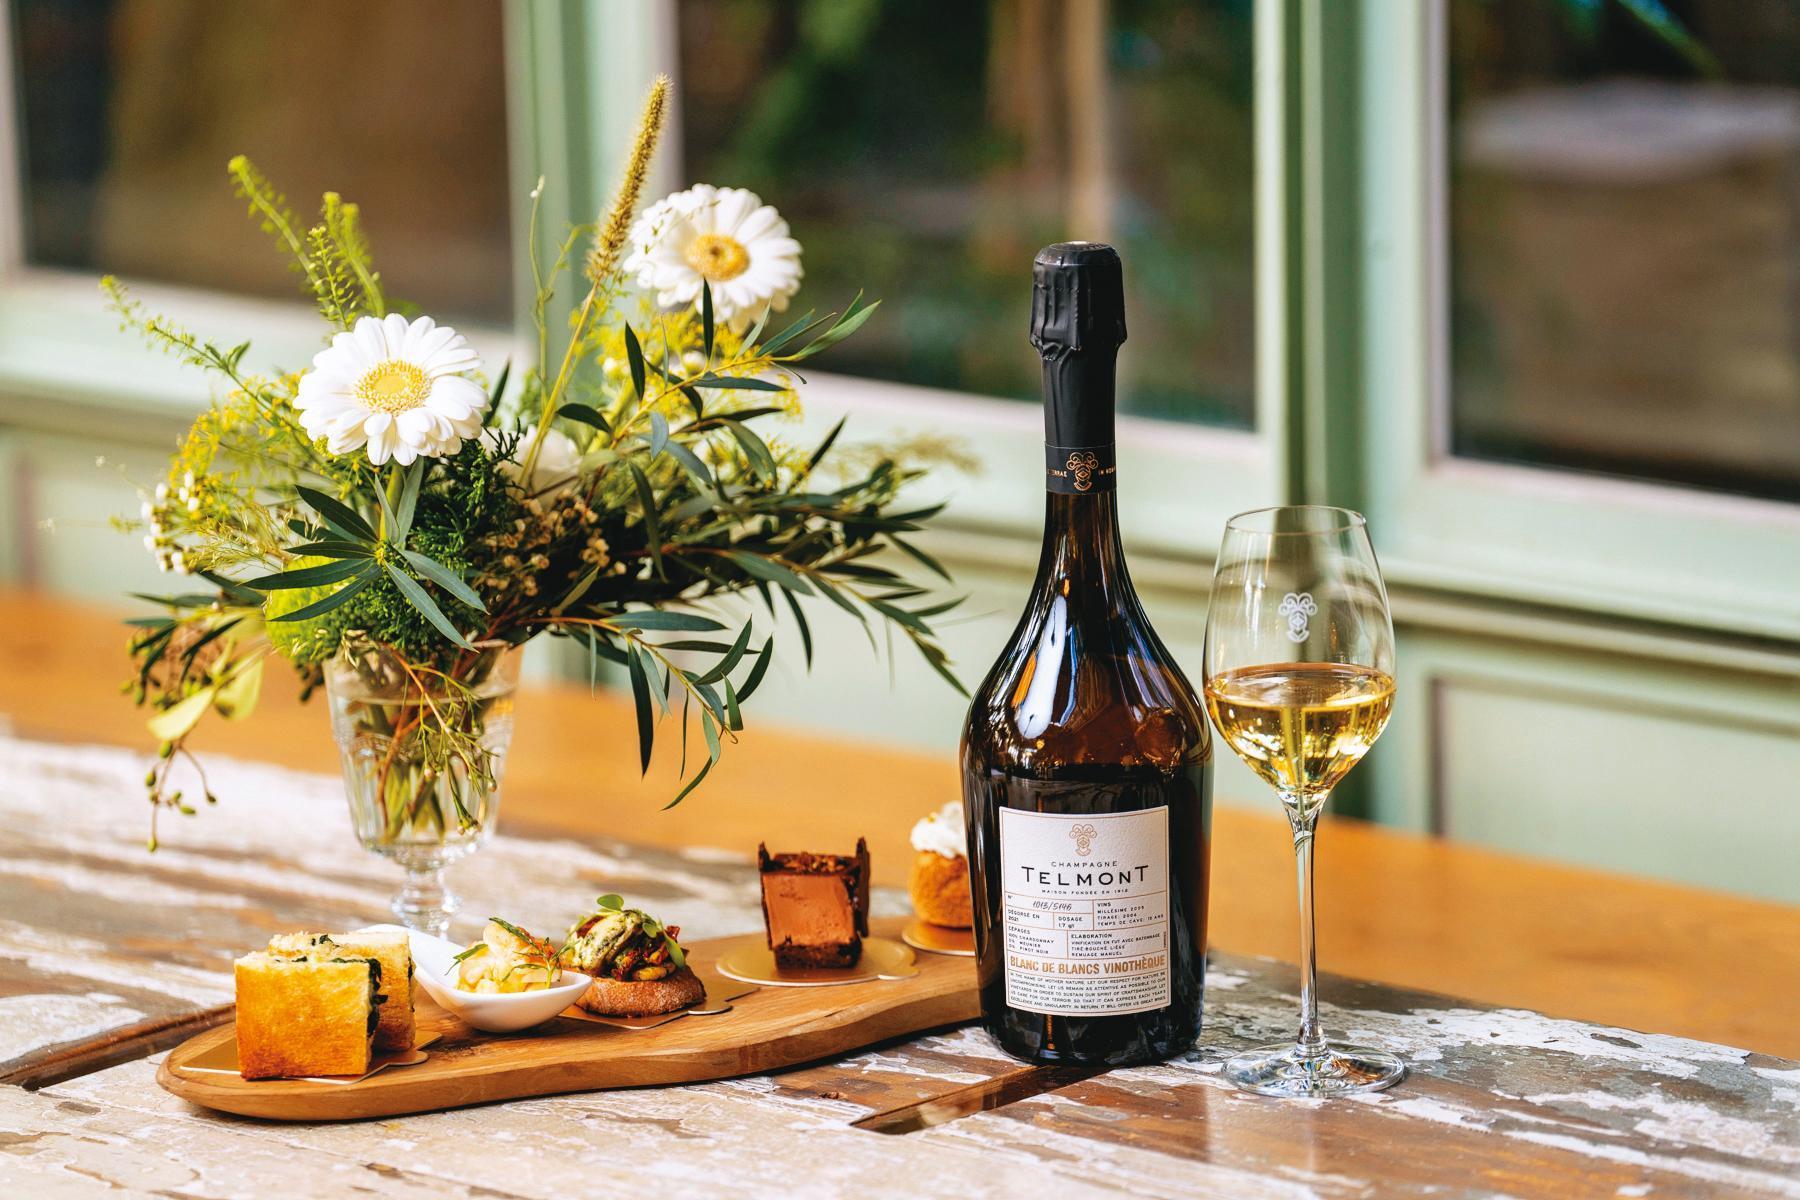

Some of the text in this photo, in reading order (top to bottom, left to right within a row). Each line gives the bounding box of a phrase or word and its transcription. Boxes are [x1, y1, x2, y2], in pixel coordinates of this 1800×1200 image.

[1021, 864, 1148, 886] TELMONT
[1033, 900, 1072, 911] 1013/5146
[1020, 935, 1054, 944] CHARDONNAY
[1010, 955, 1165, 974] BLANC DE BLANCS VINOTHÈQUE
[1011, 996, 1032, 1005] EXCELLENCE
